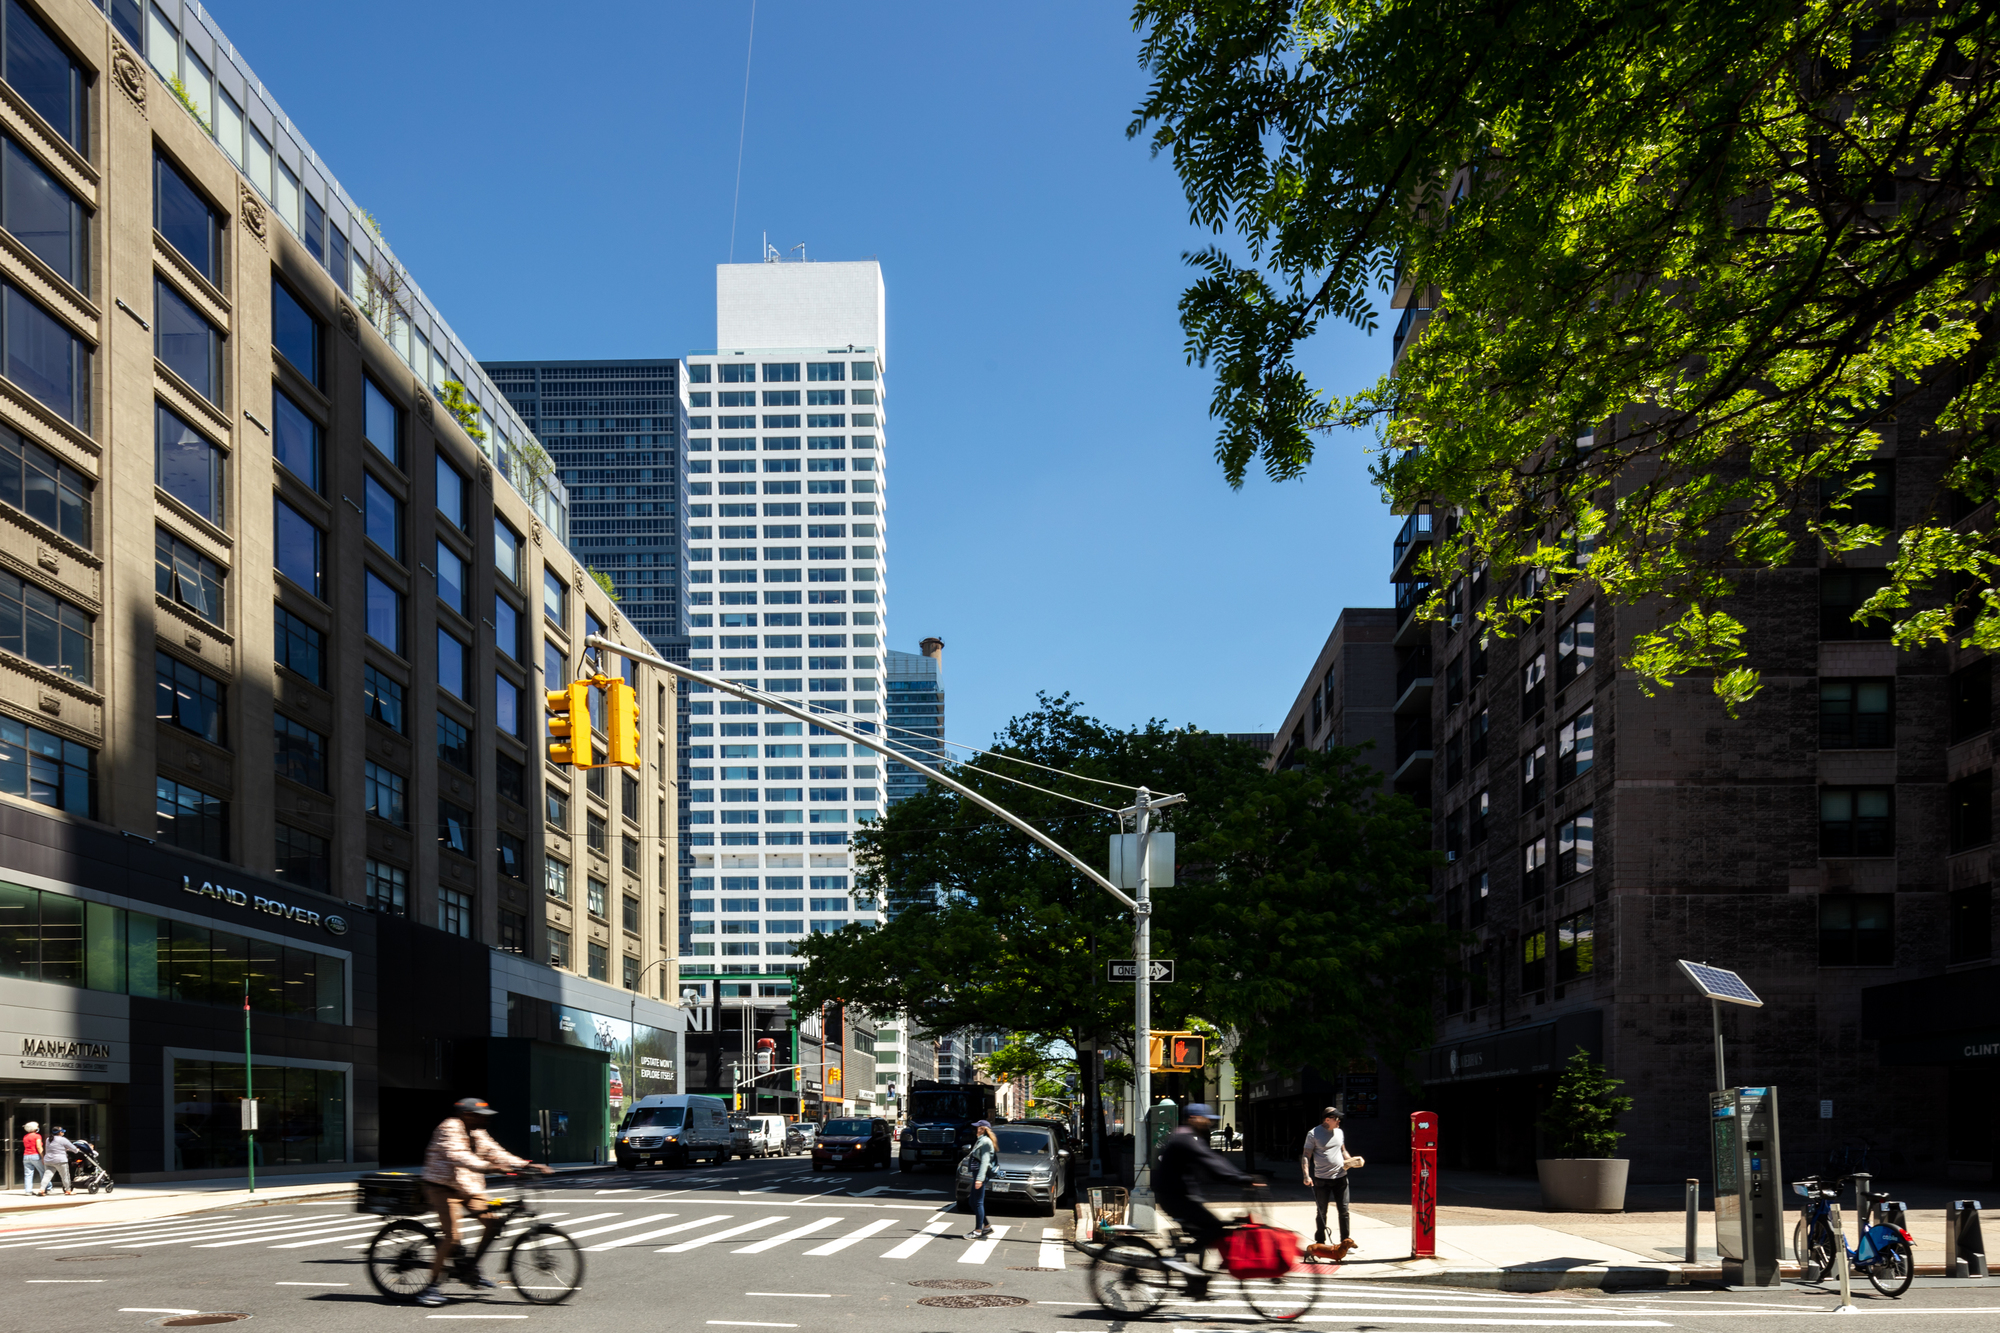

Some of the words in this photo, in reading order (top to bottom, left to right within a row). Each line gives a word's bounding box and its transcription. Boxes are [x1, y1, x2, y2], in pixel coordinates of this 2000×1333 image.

[183, 875, 247, 906] LAND
[253, 895, 320, 927] ROVER
[1118, 966, 1136, 975] ONE
[22, 1038, 110, 1058] MANHATTAN
[1964, 1042, 2000, 1057] CLINT
[48, 1061, 75, 1069] ENTRANCE
[641, 1056, 659, 1067] UPSTATE
[660, 1059, 673, 1069] WON'T
[641, 1069, 660, 1079] EXPLORE
[660, 1071, 675, 1081] ITSELF.
